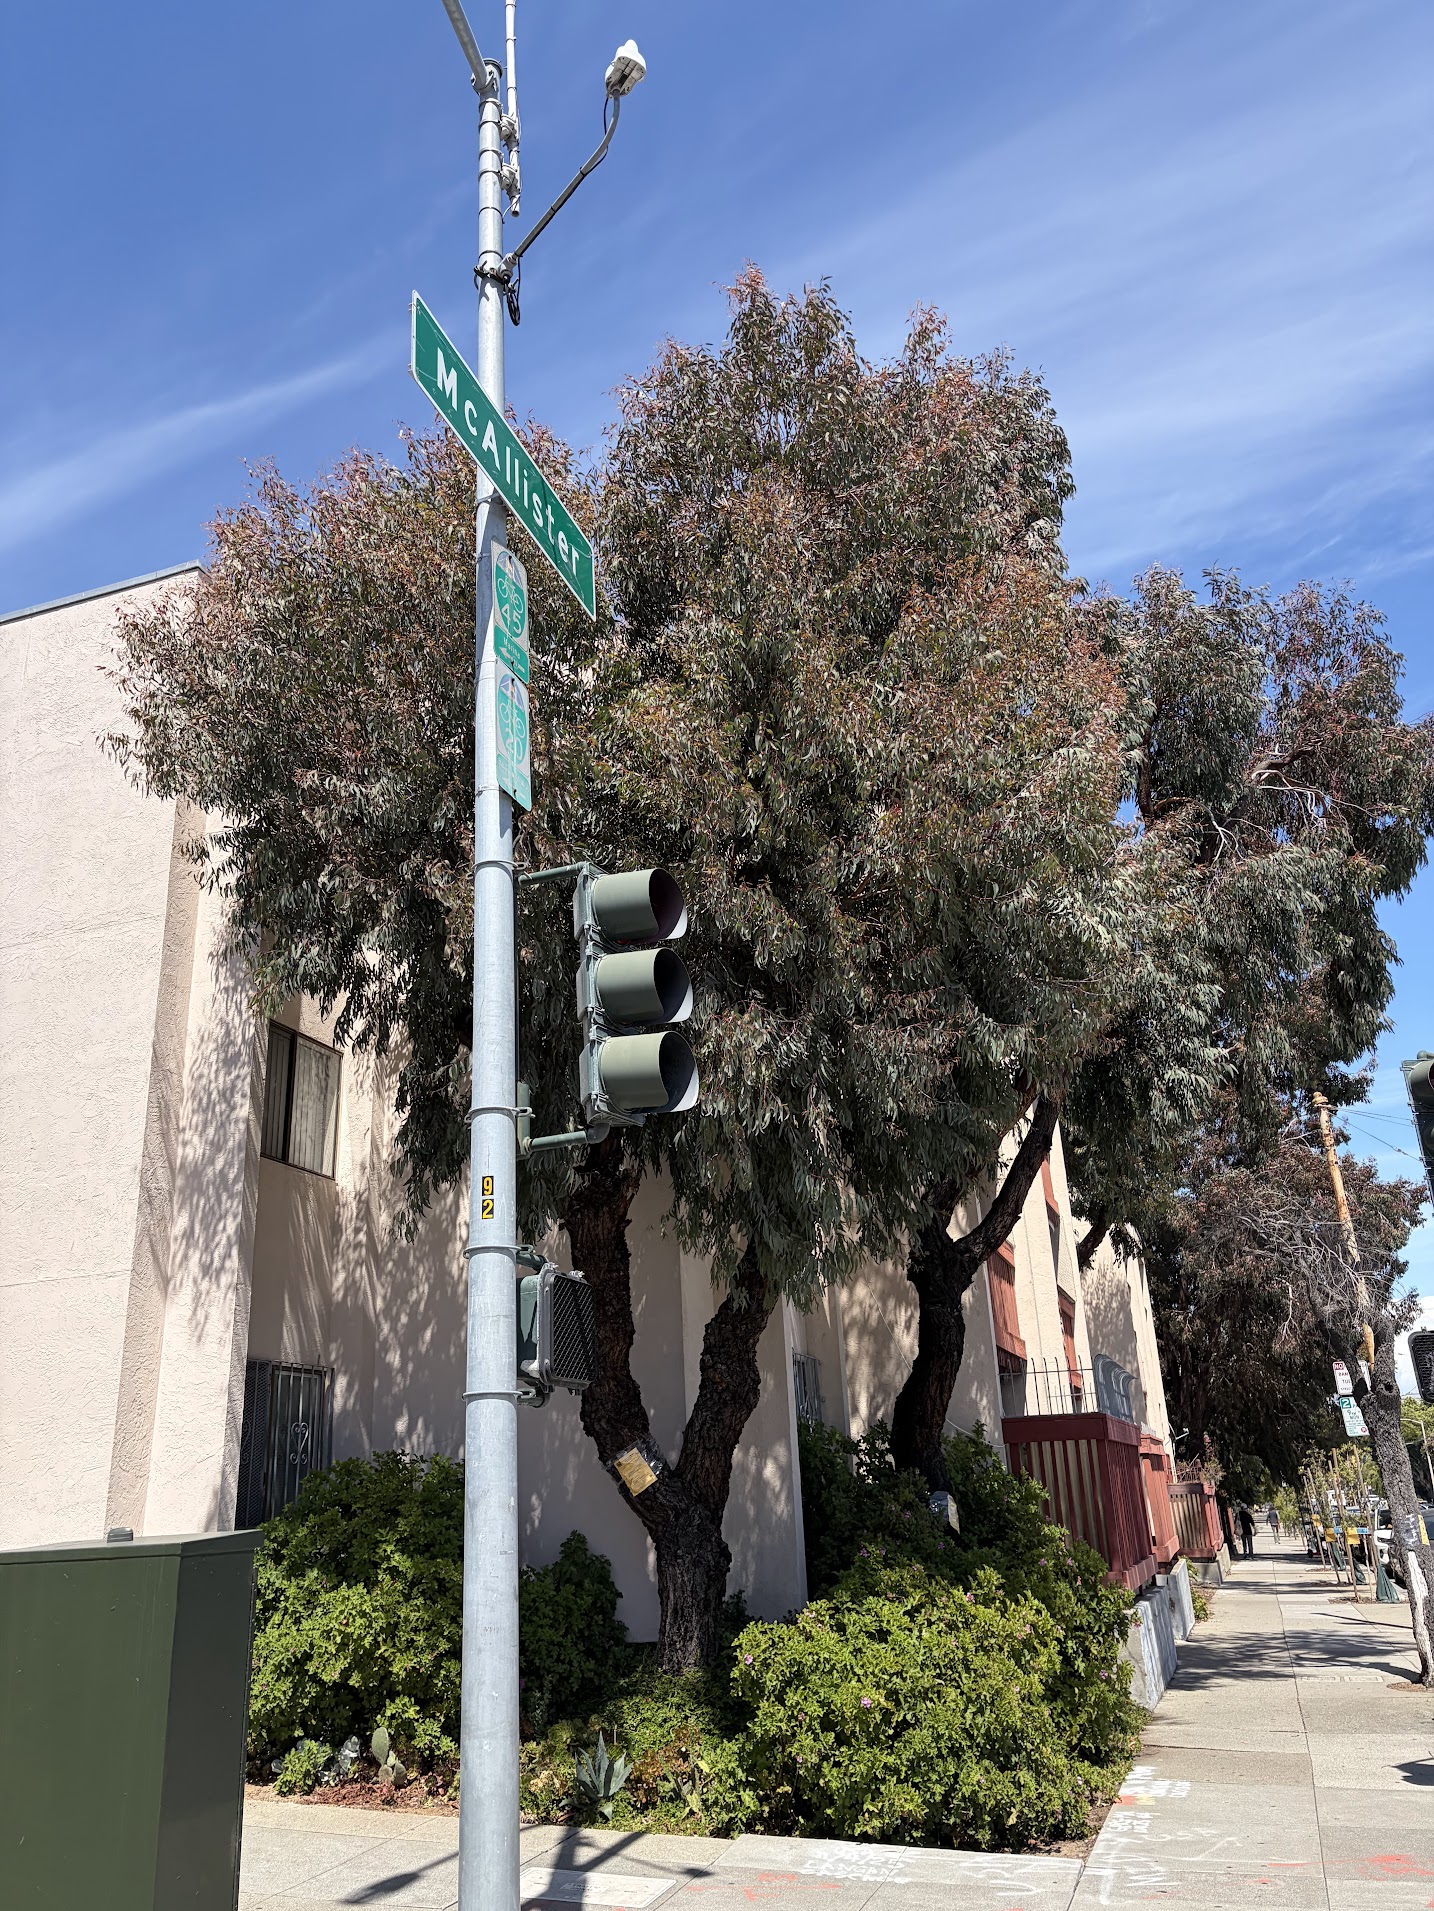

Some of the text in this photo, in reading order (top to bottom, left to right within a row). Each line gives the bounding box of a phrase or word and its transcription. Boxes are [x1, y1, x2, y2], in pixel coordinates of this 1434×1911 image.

[437, 347, 580, 577] McAllister
[501, 603, 522, 634] 45
[482, 1176, 494, 1219] 92
[1341, 1399, 1351, 1409] 2
